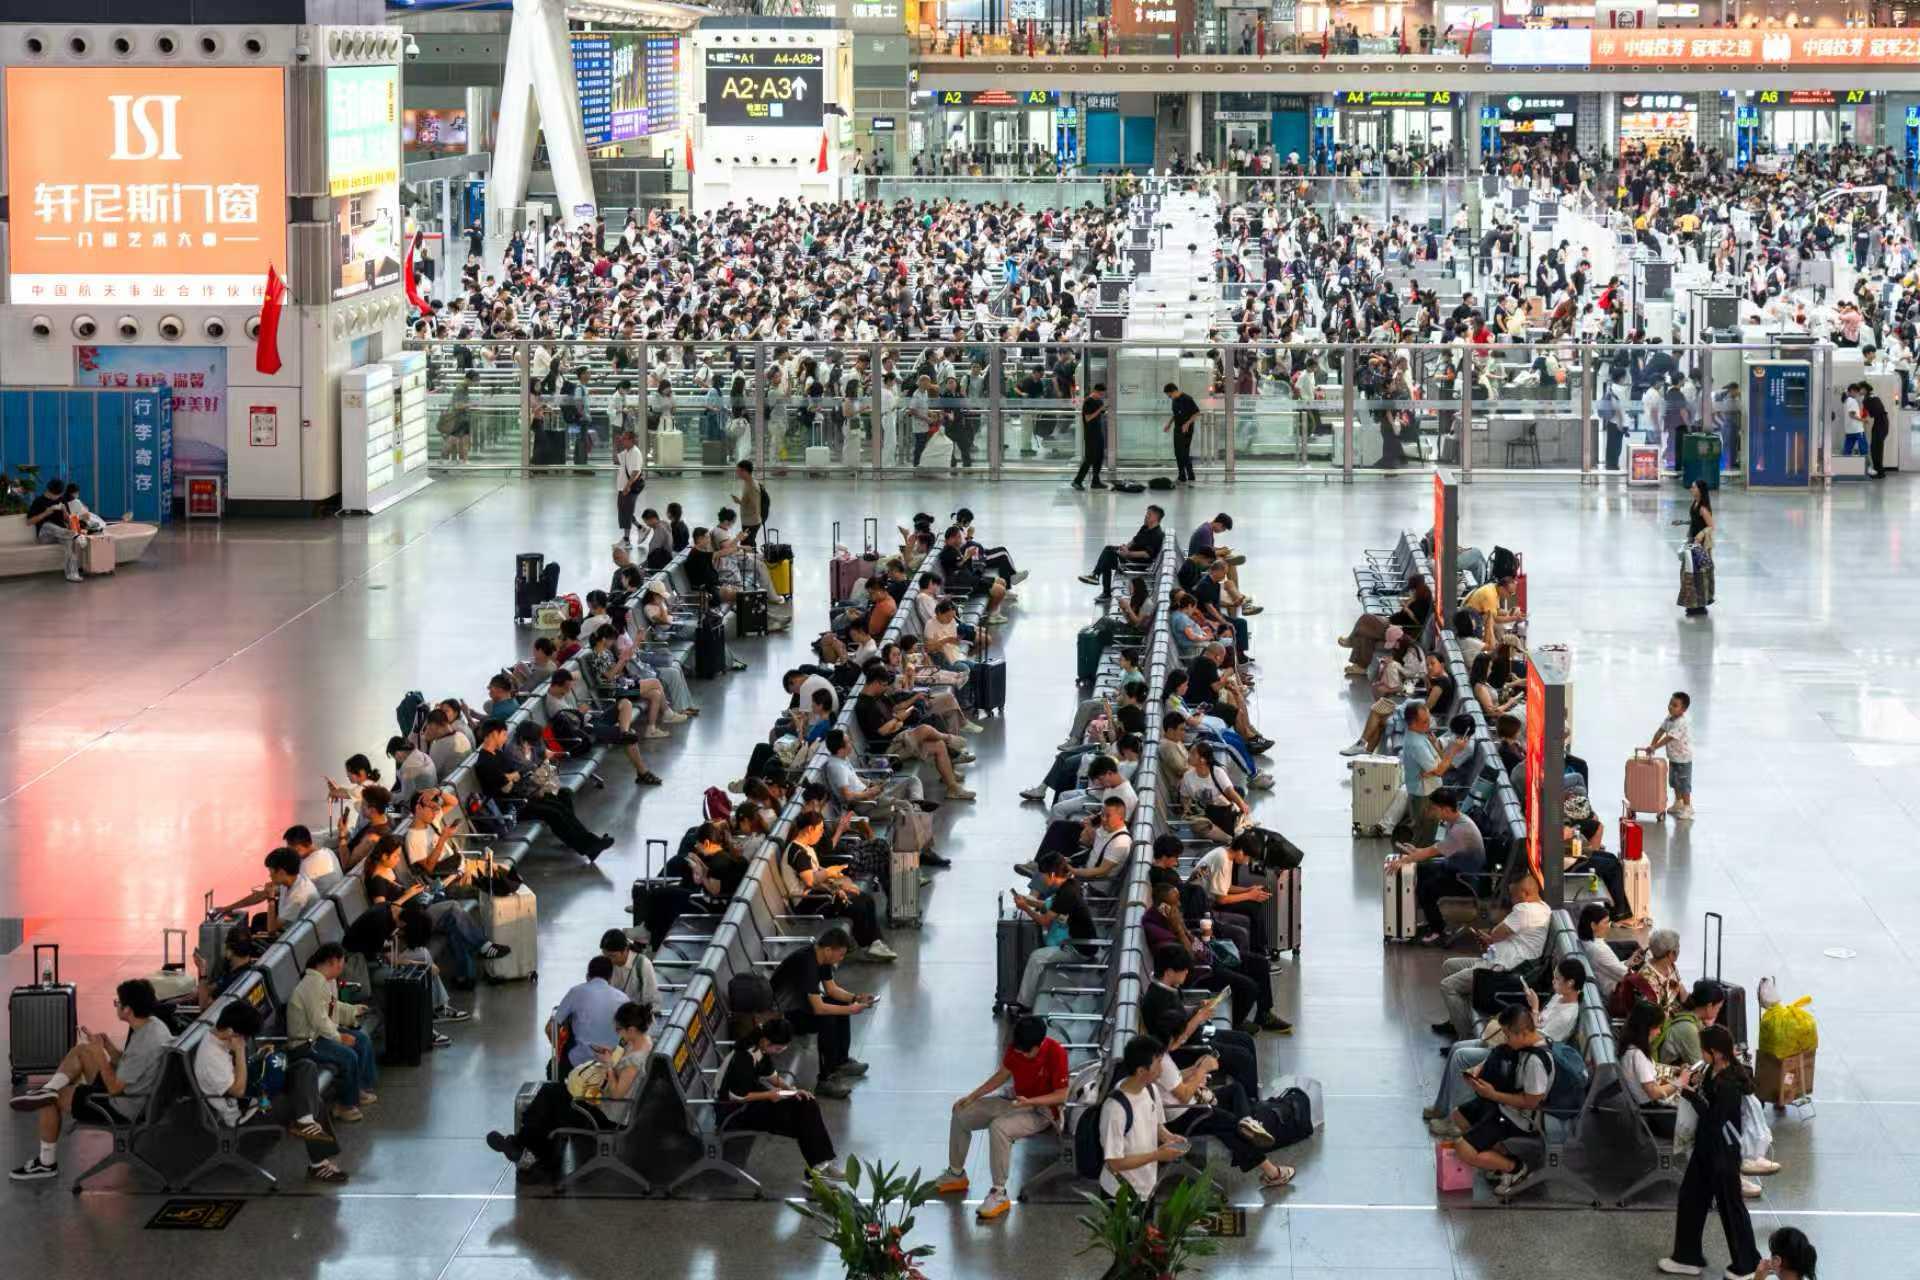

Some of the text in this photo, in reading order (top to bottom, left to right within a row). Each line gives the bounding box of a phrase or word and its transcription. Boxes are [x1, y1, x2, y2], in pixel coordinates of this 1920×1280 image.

[1625, 39, 1686, 58] 中国拉芳
[1691, 39, 1752, 58] 冠军之选
[1802, 39, 1920, 58] 中国拉芳 冠军之
[740, 53, 754, 64] A1
[774, 53, 813, 64] A4-A28
[944, 91, 962, 104] A2
[1029, 91, 1046, 104] A3
[1347, 91, 1364, 104] A4
[1432, 91, 1450, 104] A5
[1760, 91, 1778, 104] A6
[1847, 90, 1865, 103] A7
[34, 182, 261, 224] 轩尼斯门窗
[134, 398, 152, 491] 行李寄存
